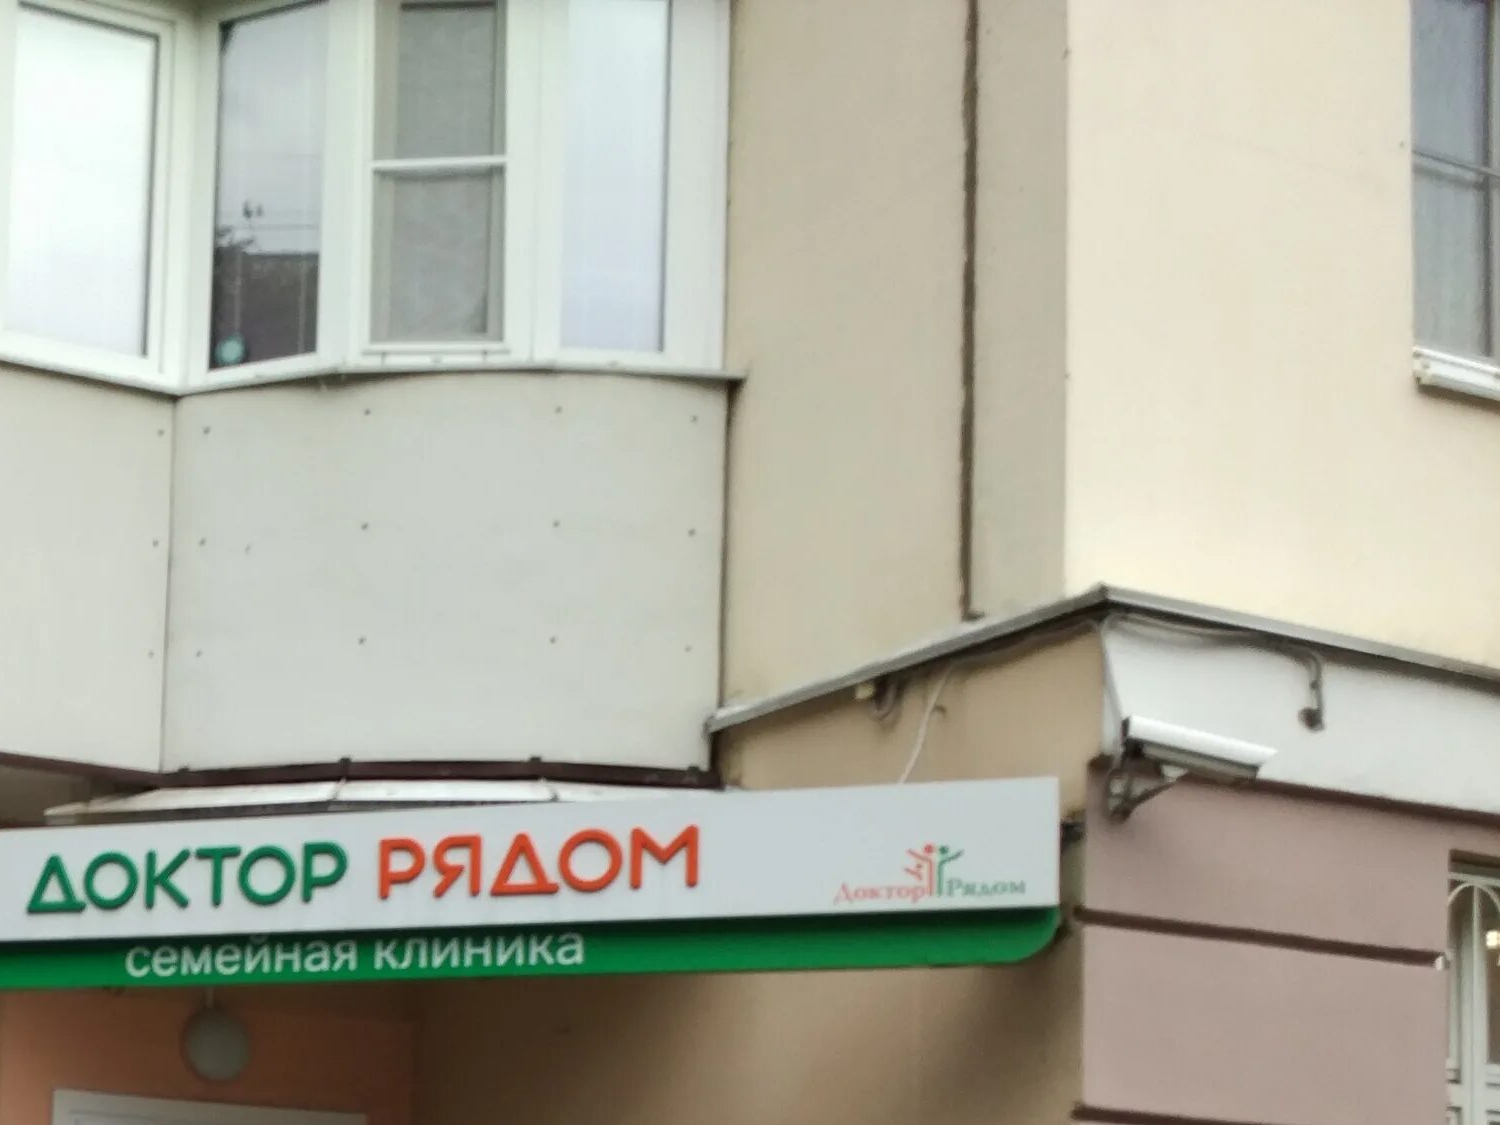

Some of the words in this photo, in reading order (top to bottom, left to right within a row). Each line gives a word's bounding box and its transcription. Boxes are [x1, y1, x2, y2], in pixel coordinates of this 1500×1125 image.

[26, 841, 348, 914] ДОКТОР
[378, 825, 699, 900] РЯДОМ
[125, 935, 358, 978] семейная
[372, 932, 585, 971] клиника
